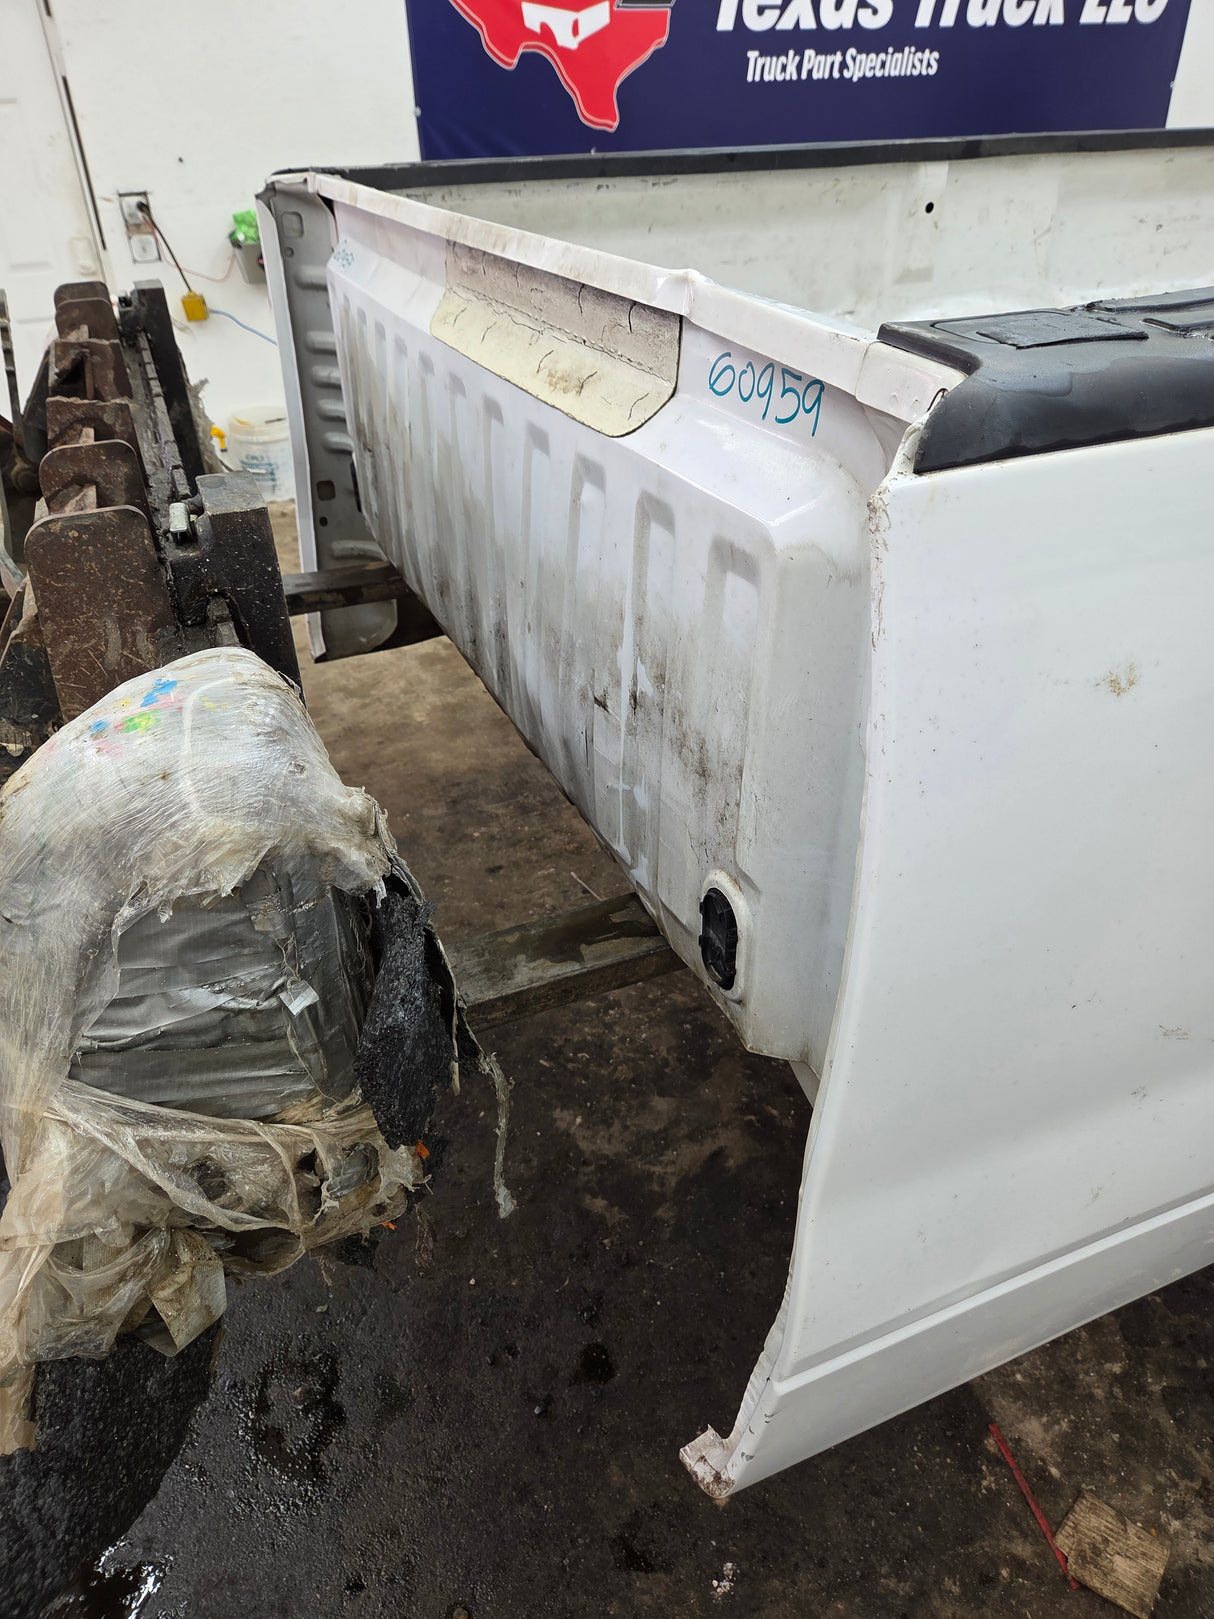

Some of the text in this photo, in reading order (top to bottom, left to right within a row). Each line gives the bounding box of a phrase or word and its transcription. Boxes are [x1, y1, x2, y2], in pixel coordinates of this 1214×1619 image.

[746, 46, 940, 83] Truck Part Specialists
[708, 351, 826, 438] 60959
